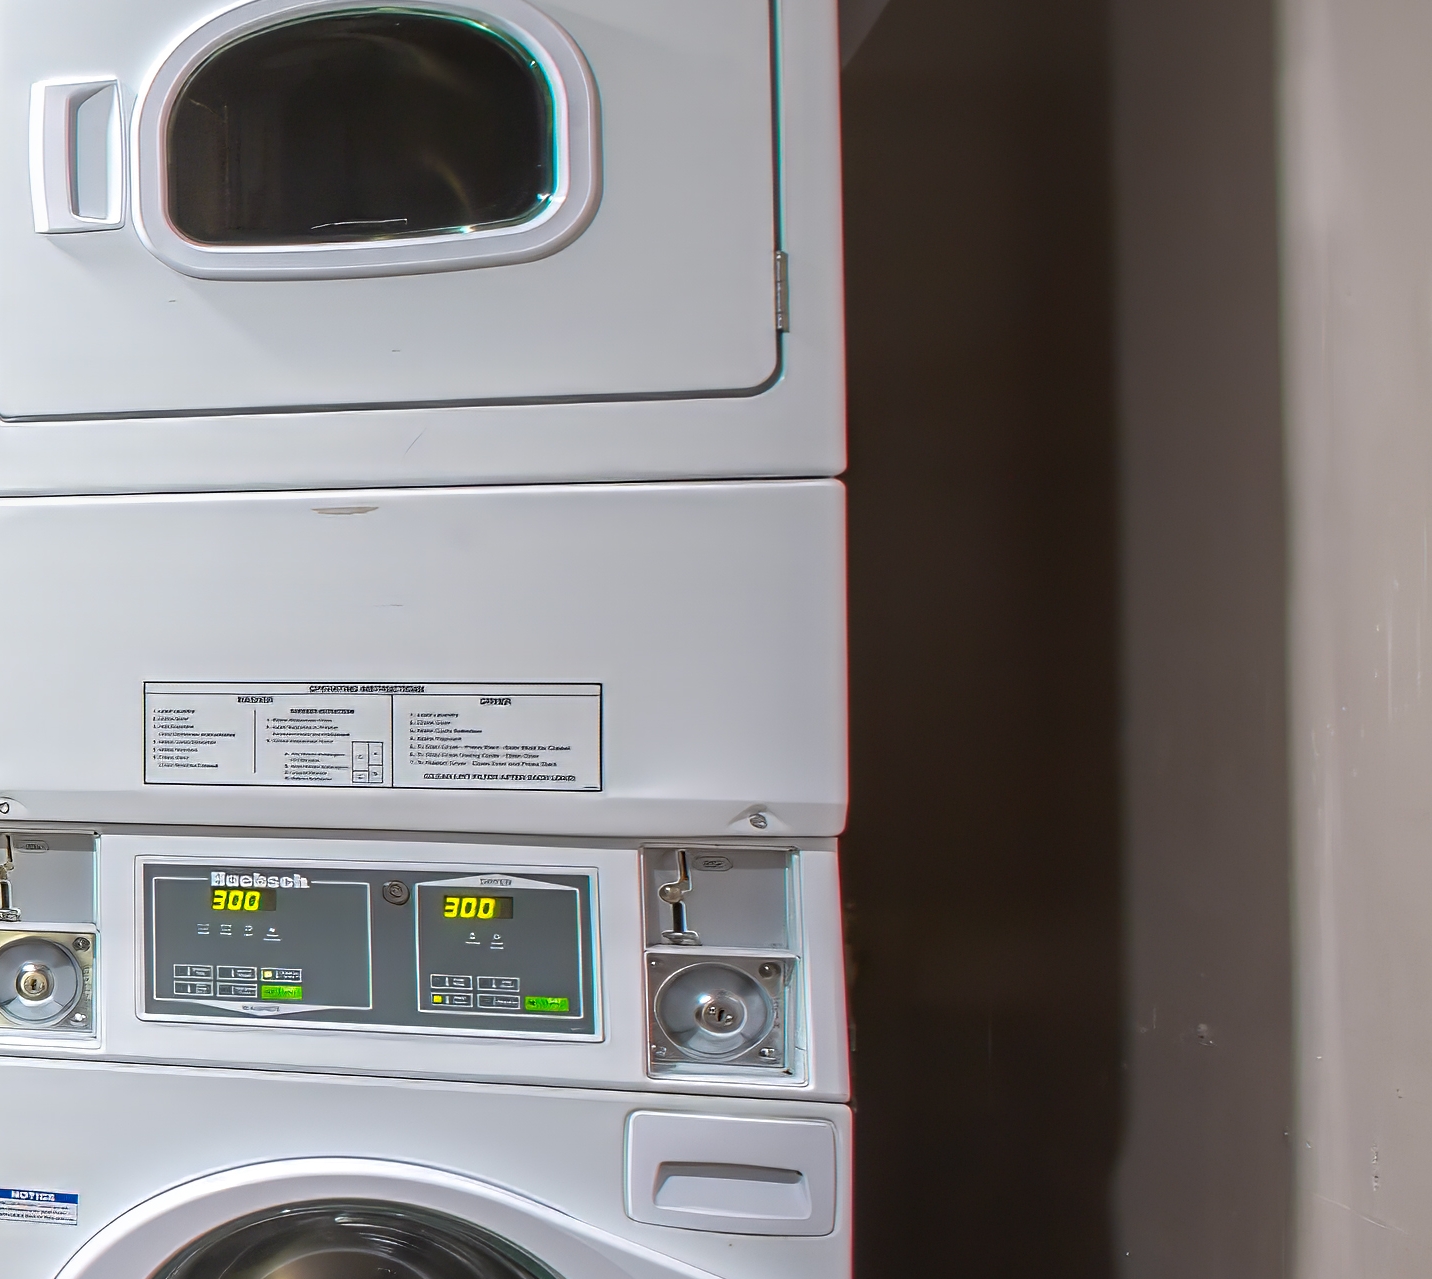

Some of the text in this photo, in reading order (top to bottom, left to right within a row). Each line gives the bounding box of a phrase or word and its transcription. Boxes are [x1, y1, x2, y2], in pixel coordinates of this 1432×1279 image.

[210, 871, 311, 889] Huebsch
[212, 889, 261, 911] 300
[443, 896, 496, 919] 300
[10, 1189, 56, 1202] NOTICE
